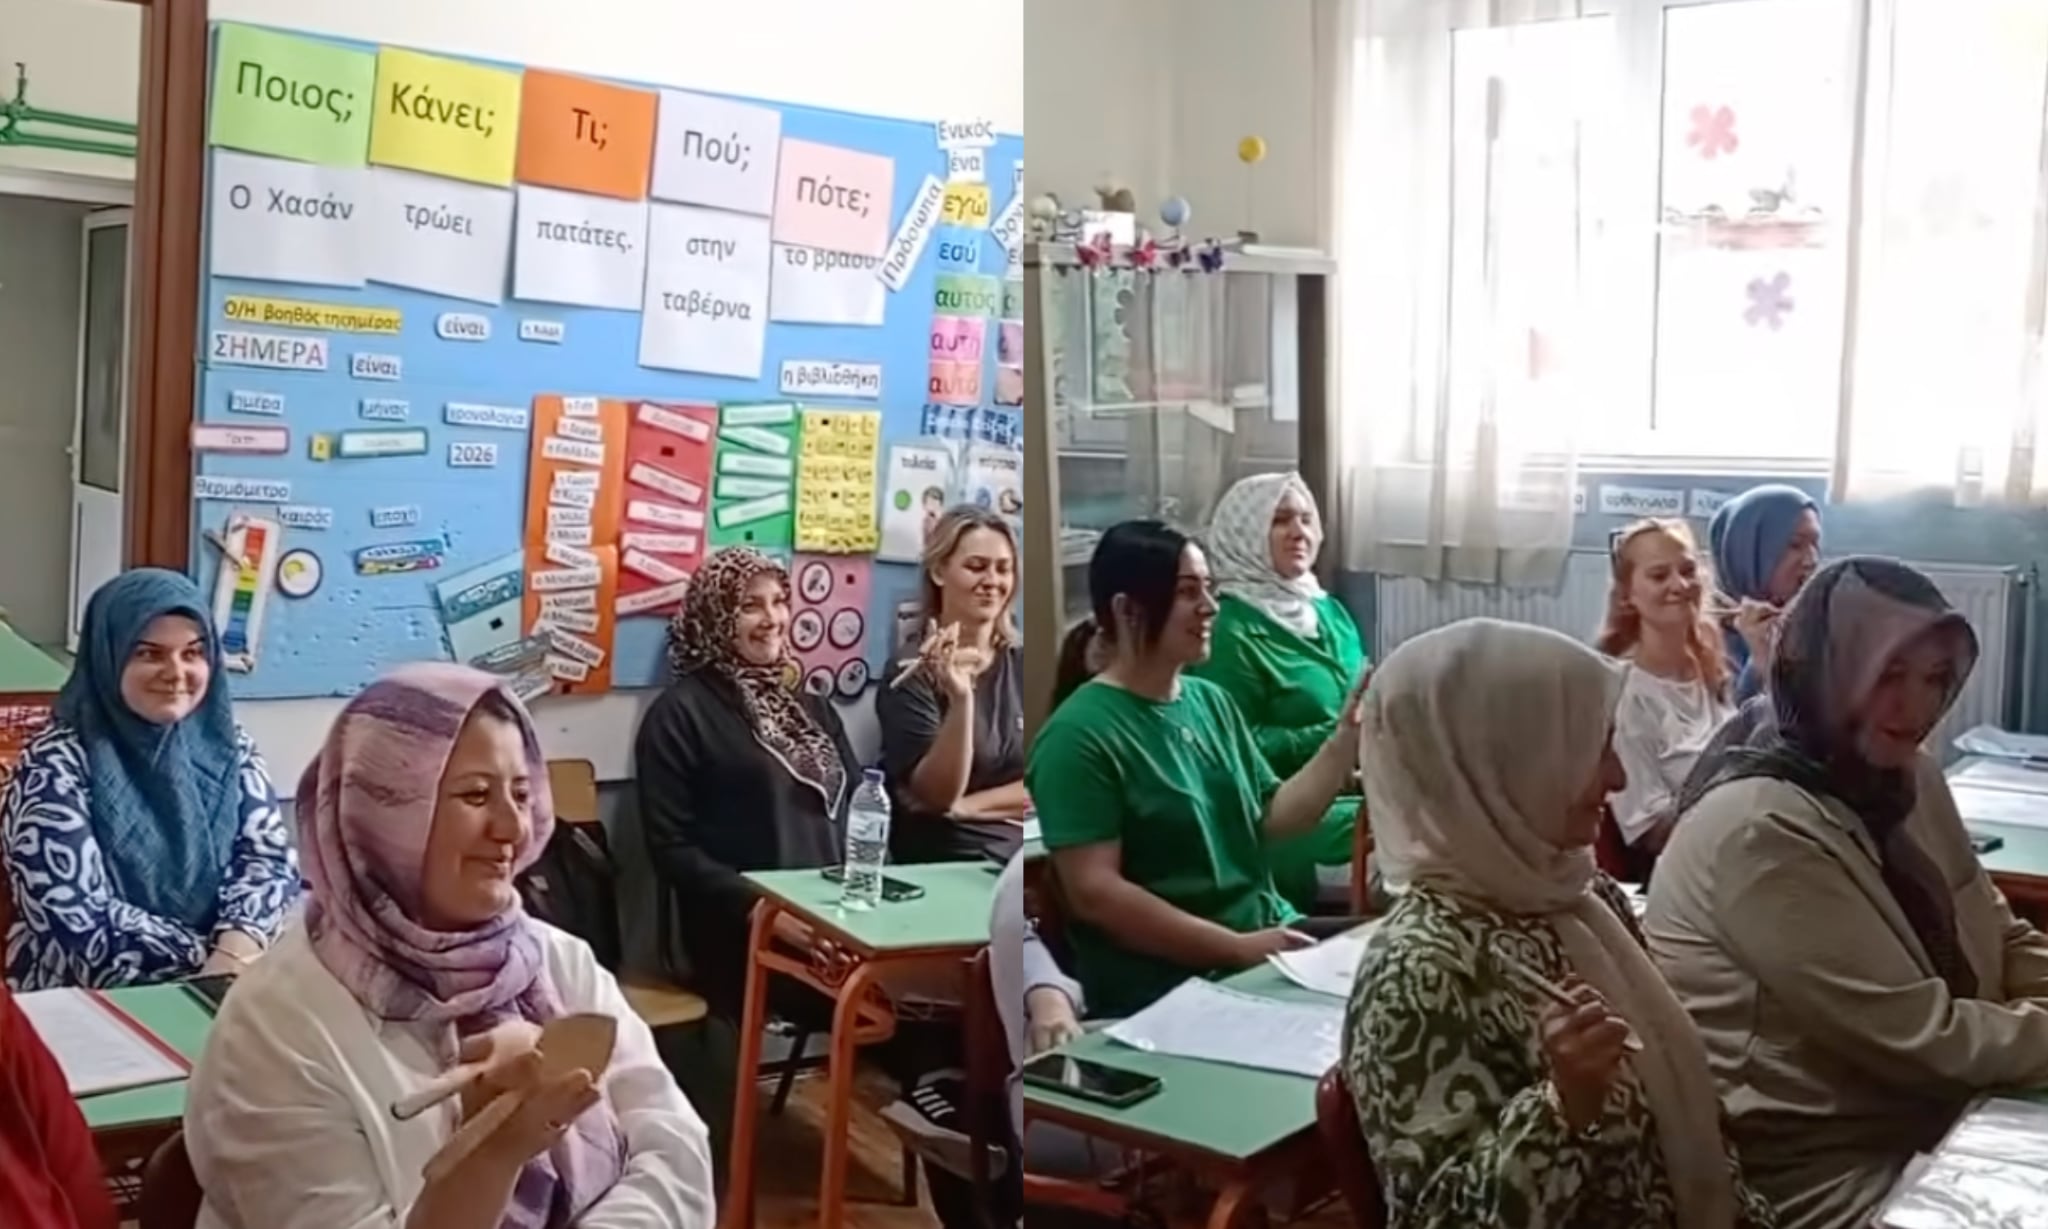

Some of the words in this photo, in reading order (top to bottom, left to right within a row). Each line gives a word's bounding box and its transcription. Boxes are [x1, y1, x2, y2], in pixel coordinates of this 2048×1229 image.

[236, 61, 354, 122] Ποιος;
[390, 81, 495, 136] Κάνει;
[572, 108, 608, 150] Τι;
[938, 117, 994, 142] Ενικός
[683, 130, 751, 172] Πού;
[950, 153, 980, 173] ένα
[230, 184, 252, 210] Ο
[267, 187, 353, 221] Χασάν
[797, 175, 871, 218] Πότε;
[943, 191, 988, 220] εγώ
[404, 201, 472, 237] τρώει
[537, 219, 633, 254] πατάτες.
[686, 237, 735, 263] στην
[938, 239, 976, 263] εσύ
[785, 249, 808, 266] το
[264, 303, 319, 326] βοηθός
[663, 290, 751, 321] ταβέρνα
[445, 316, 485, 337] είναι
[215, 334, 323, 365] ΣΗΜΕΡΑ
[356, 354, 397, 376] είναι
[784, 369, 793, 386] η
[454, 445, 493, 462] 2026
